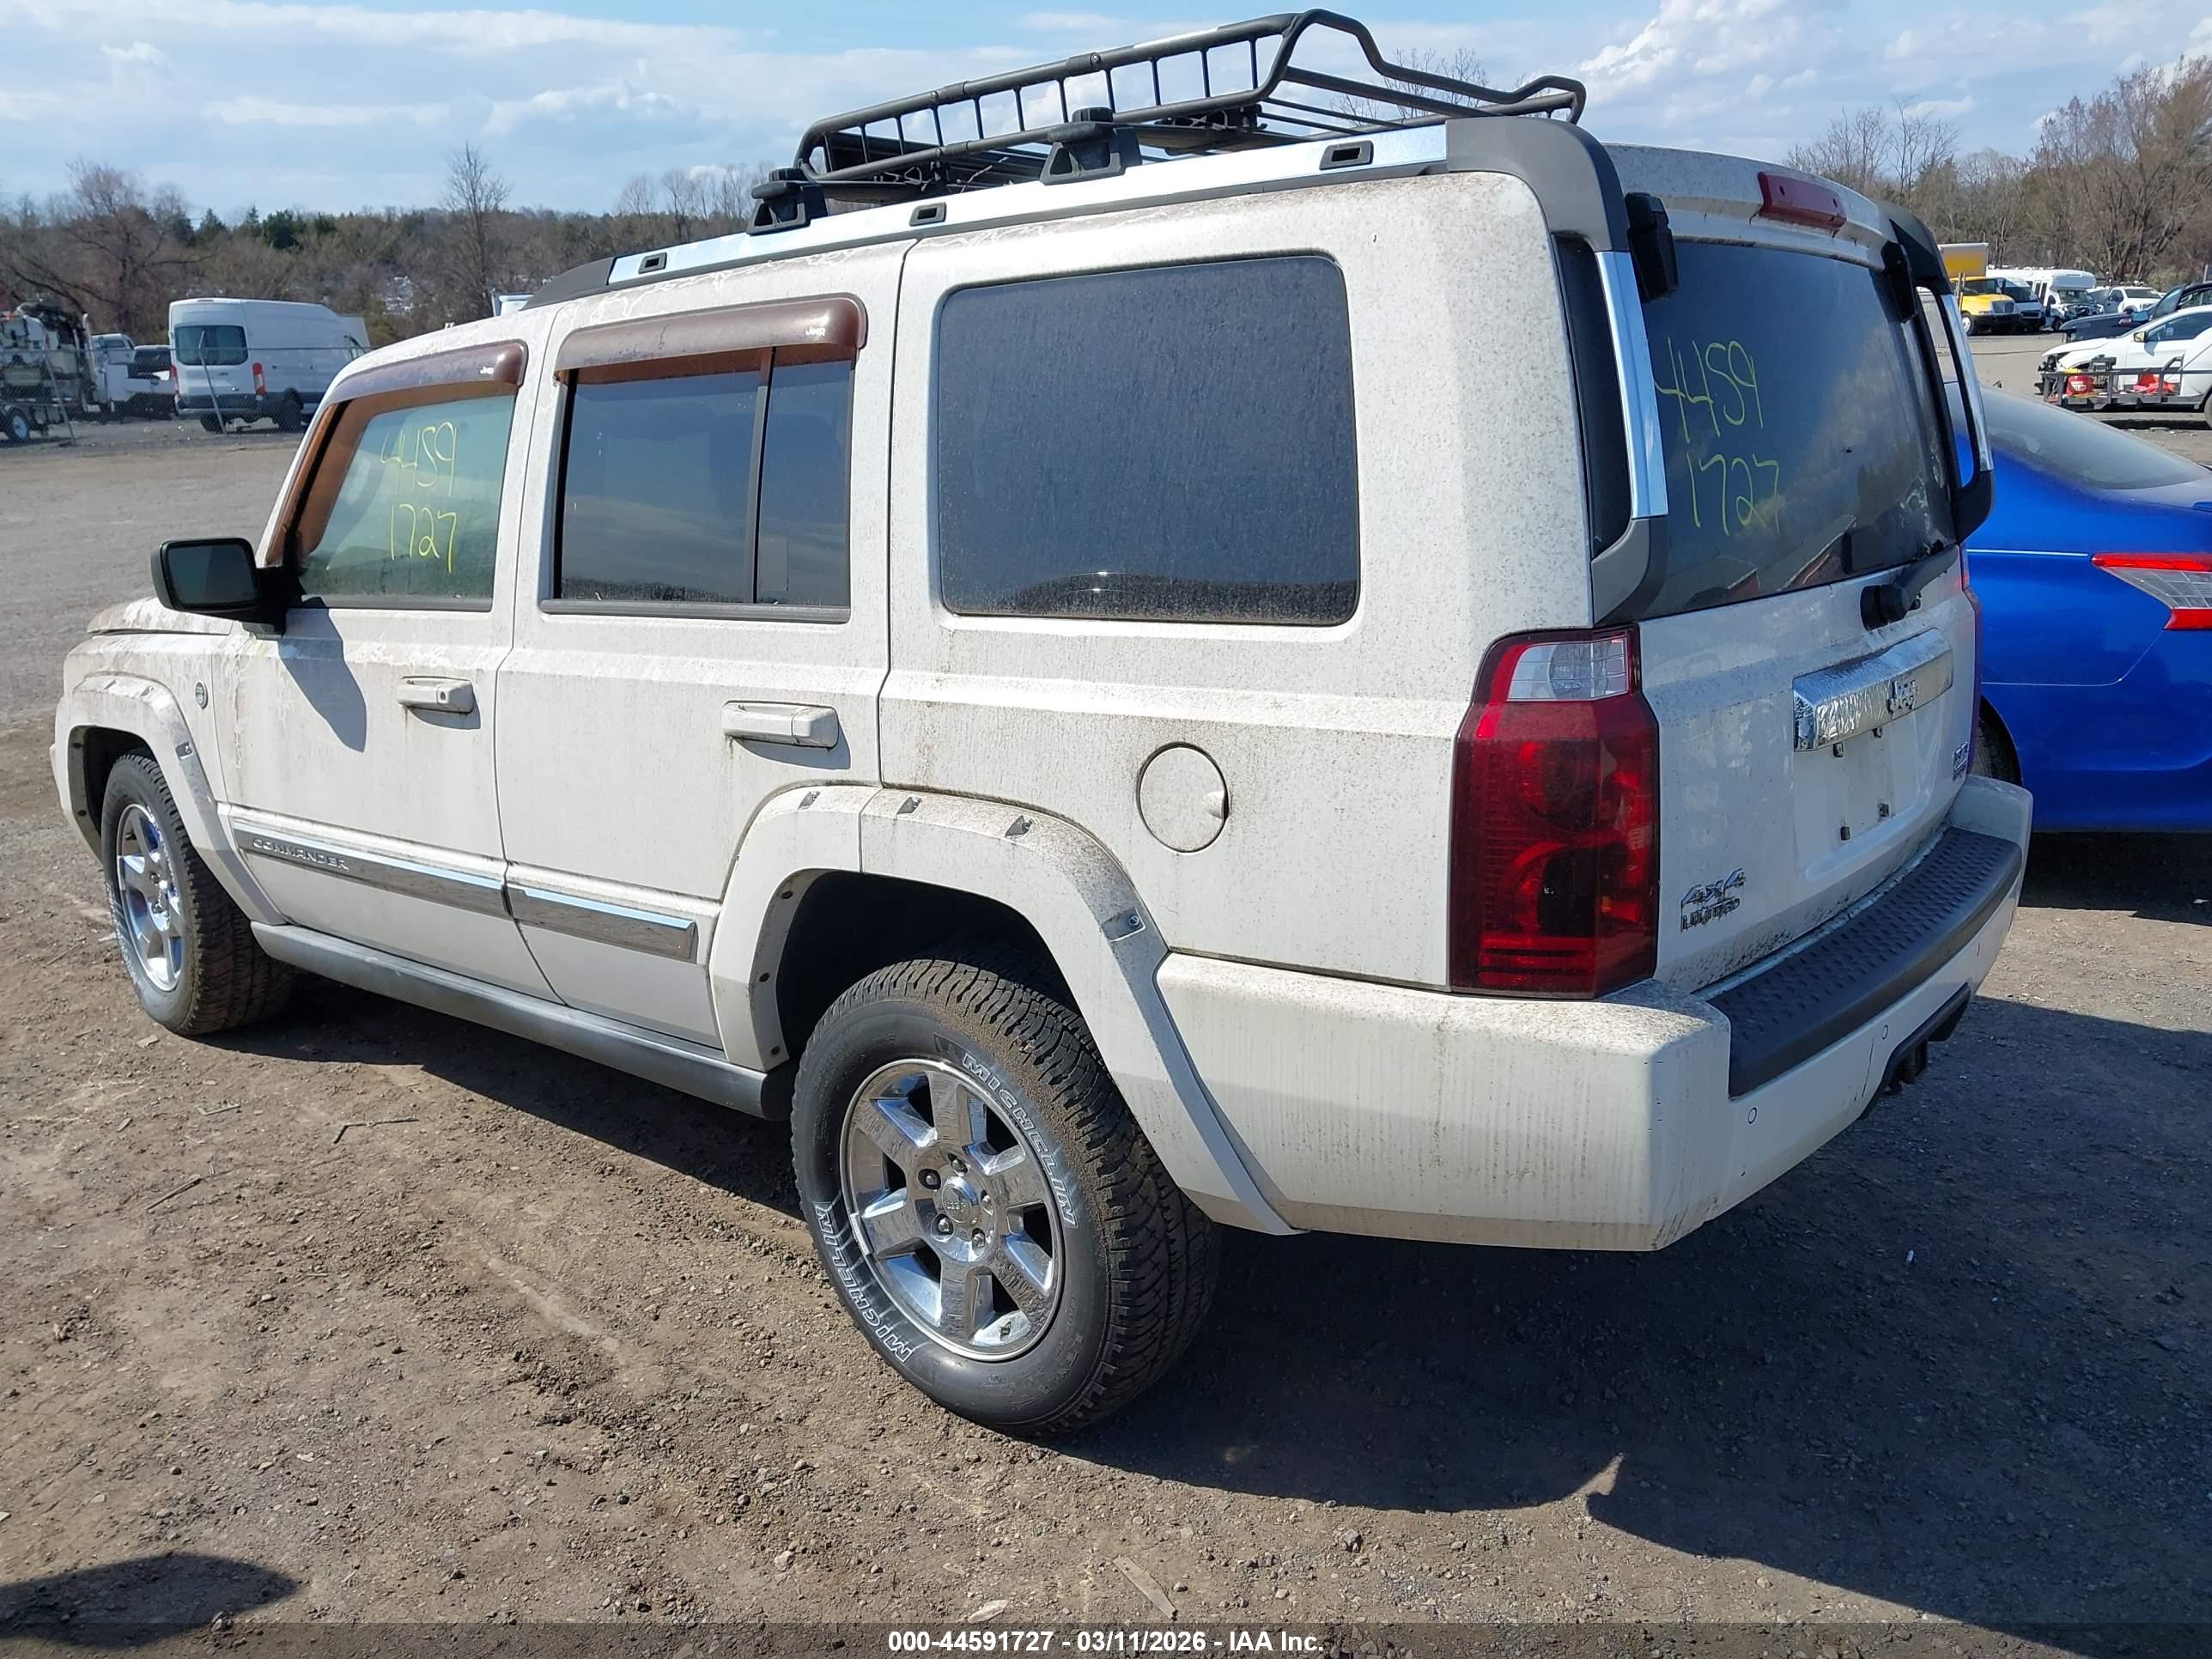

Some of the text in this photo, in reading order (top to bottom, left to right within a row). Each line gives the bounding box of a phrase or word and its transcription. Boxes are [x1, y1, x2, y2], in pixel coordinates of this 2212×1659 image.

[805, 325, 826, 337] Jeep
[1654, 337, 1764, 444] 4459
[380, 422, 458, 497] 4459
[1686, 452, 1781, 536] 1727
[390, 502, 457, 574] 1727
[252, 837, 349, 871] COMMANDER
[962, 1052, 1079, 1231] MICHELIN
[815, 1205, 914, 1363] MICHELIN
